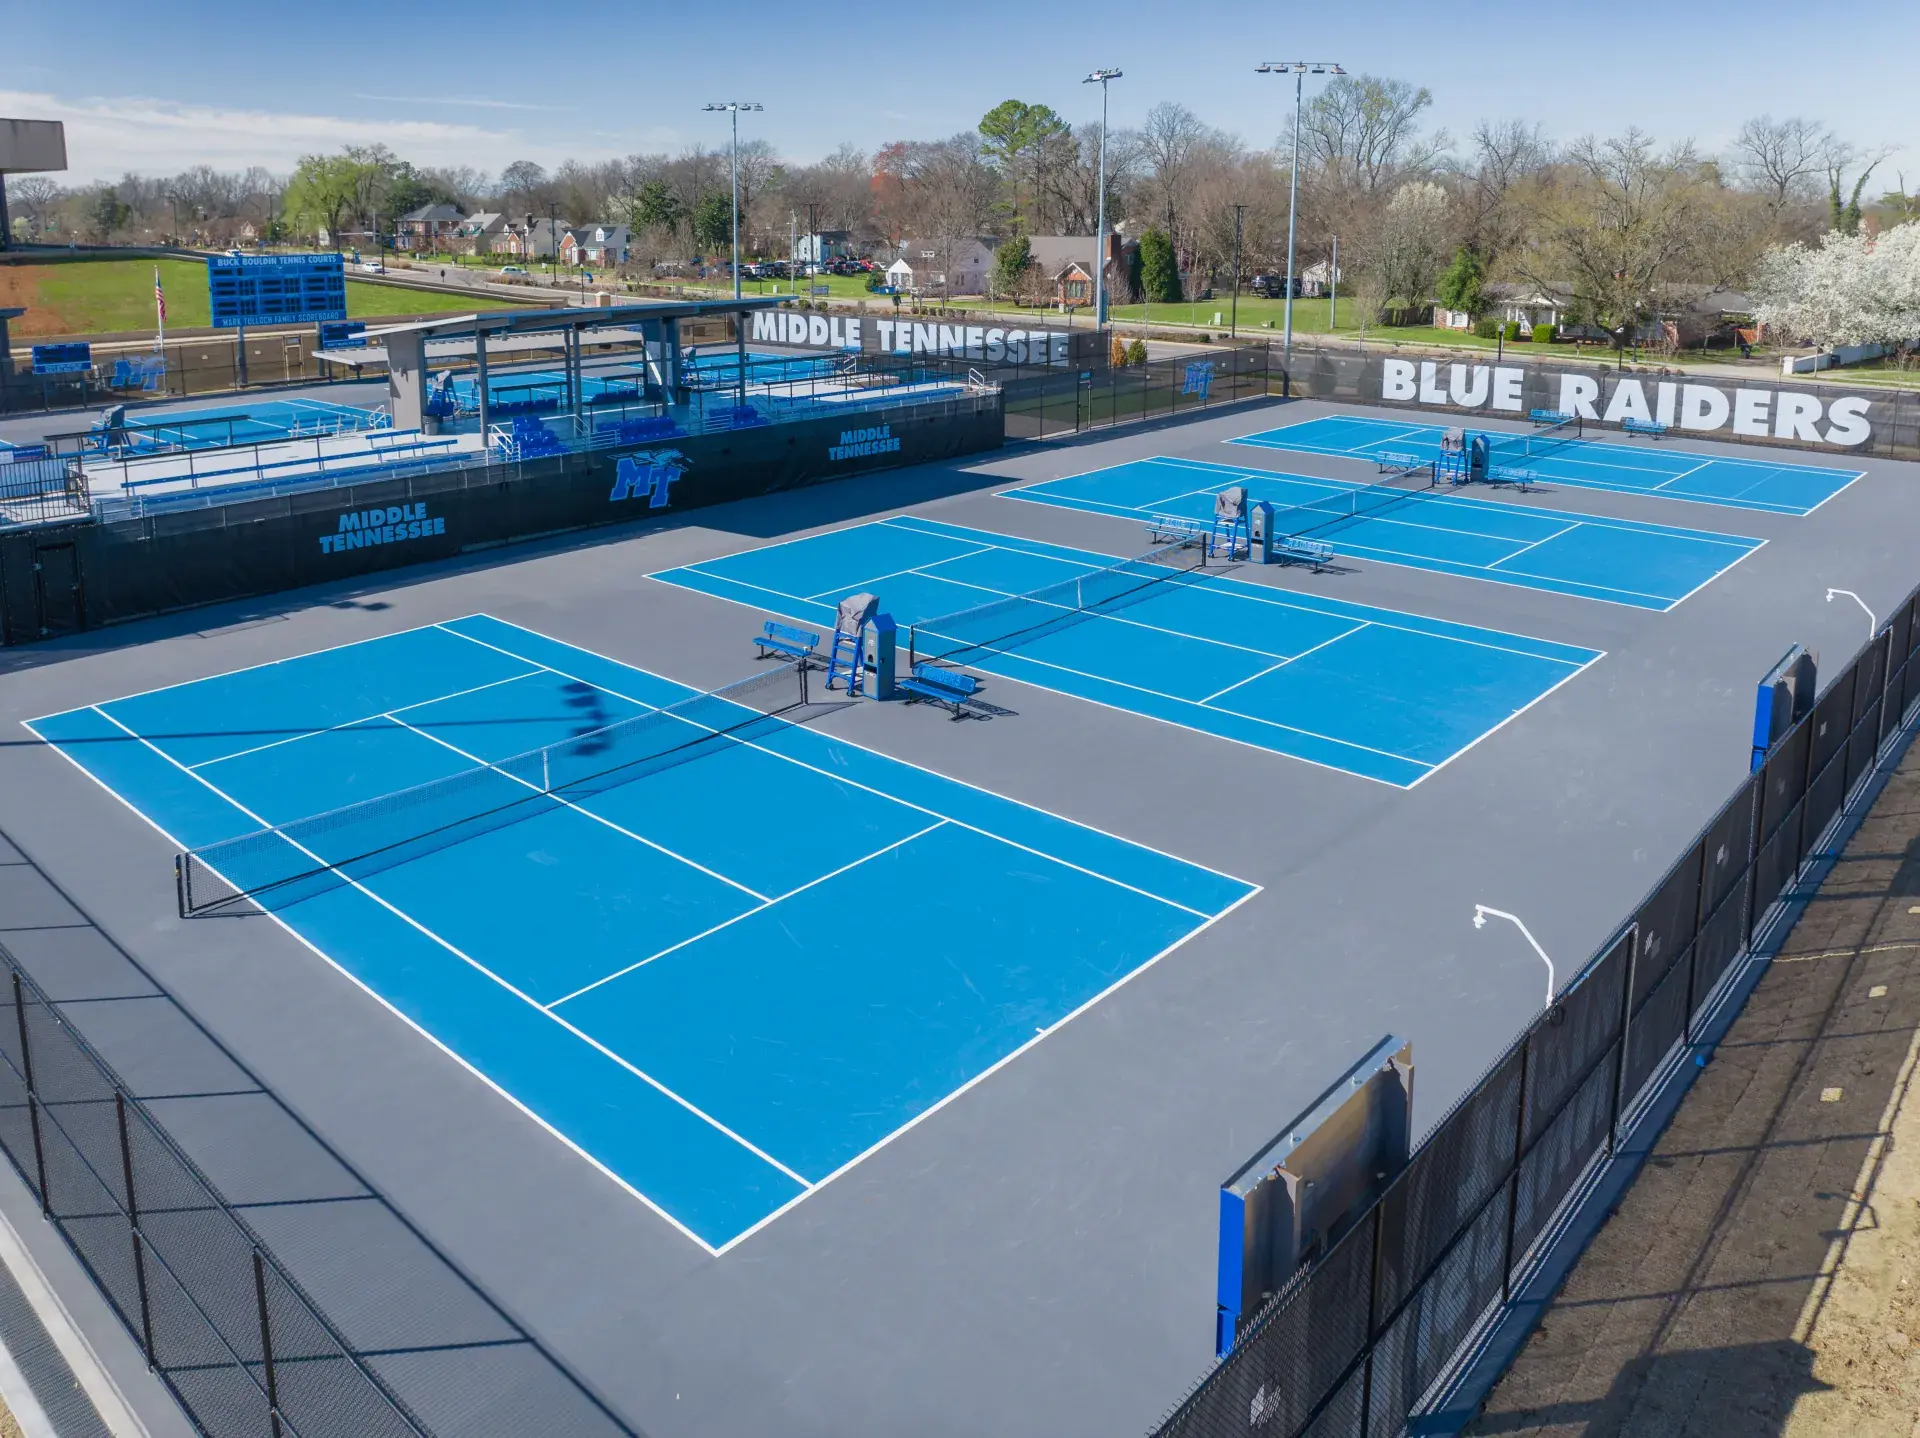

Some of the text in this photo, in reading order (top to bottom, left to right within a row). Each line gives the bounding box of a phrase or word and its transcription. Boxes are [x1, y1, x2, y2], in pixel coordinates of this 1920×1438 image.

[217, 254, 337, 267] BUCK BOULDIN TENNIS COURTS
[243, 315, 273, 325] TULLOCH
[274, 314, 297, 323] FAMILY
[298, 311, 339, 322] SCOREBOARD
[752, 311, 1069, 367] MIDDLE TENNESSEE
[1383, 358, 1872, 446] BLUE RAIDERS
[828, 437, 901, 461] TENNESSEE
[840, 425, 890, 445] MIDDLE
[610, 457, 681, 509] MT
[338, 502, 427, 533] MIDDLE
[319, 517, 446, 554] TENNESSEE
